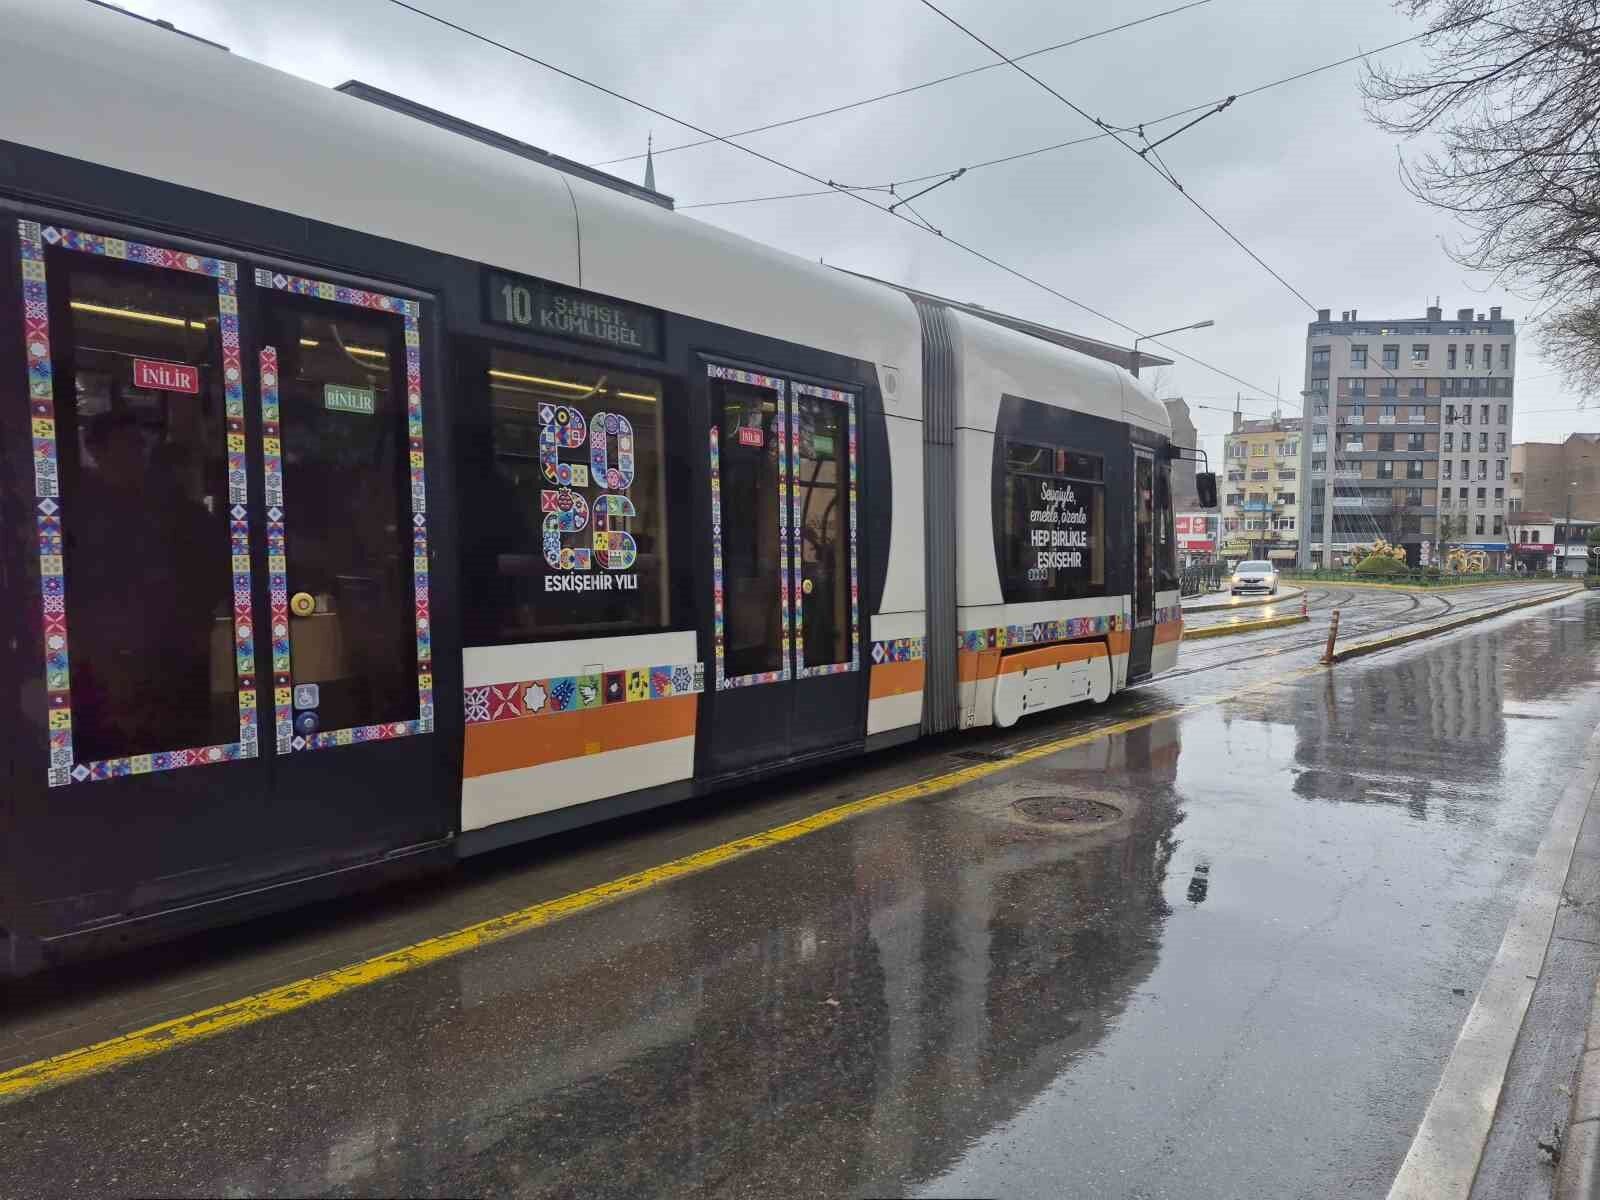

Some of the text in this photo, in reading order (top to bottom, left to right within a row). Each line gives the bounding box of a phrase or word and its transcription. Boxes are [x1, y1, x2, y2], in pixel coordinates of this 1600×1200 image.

[501, 284, 532, 325] 10
[142, 364, 191, 389] İNİLİR
[327, 390, 372, 410] BİNİLİR
[538, 402, 635, 490] 20
[1031, 527, 1087, 546] HEP BİRLİKLE
[1037, 548, 1082, 570] ESKİŞEHİR
[544, 571, 638, 593] ESKİŞEHİR YILI
